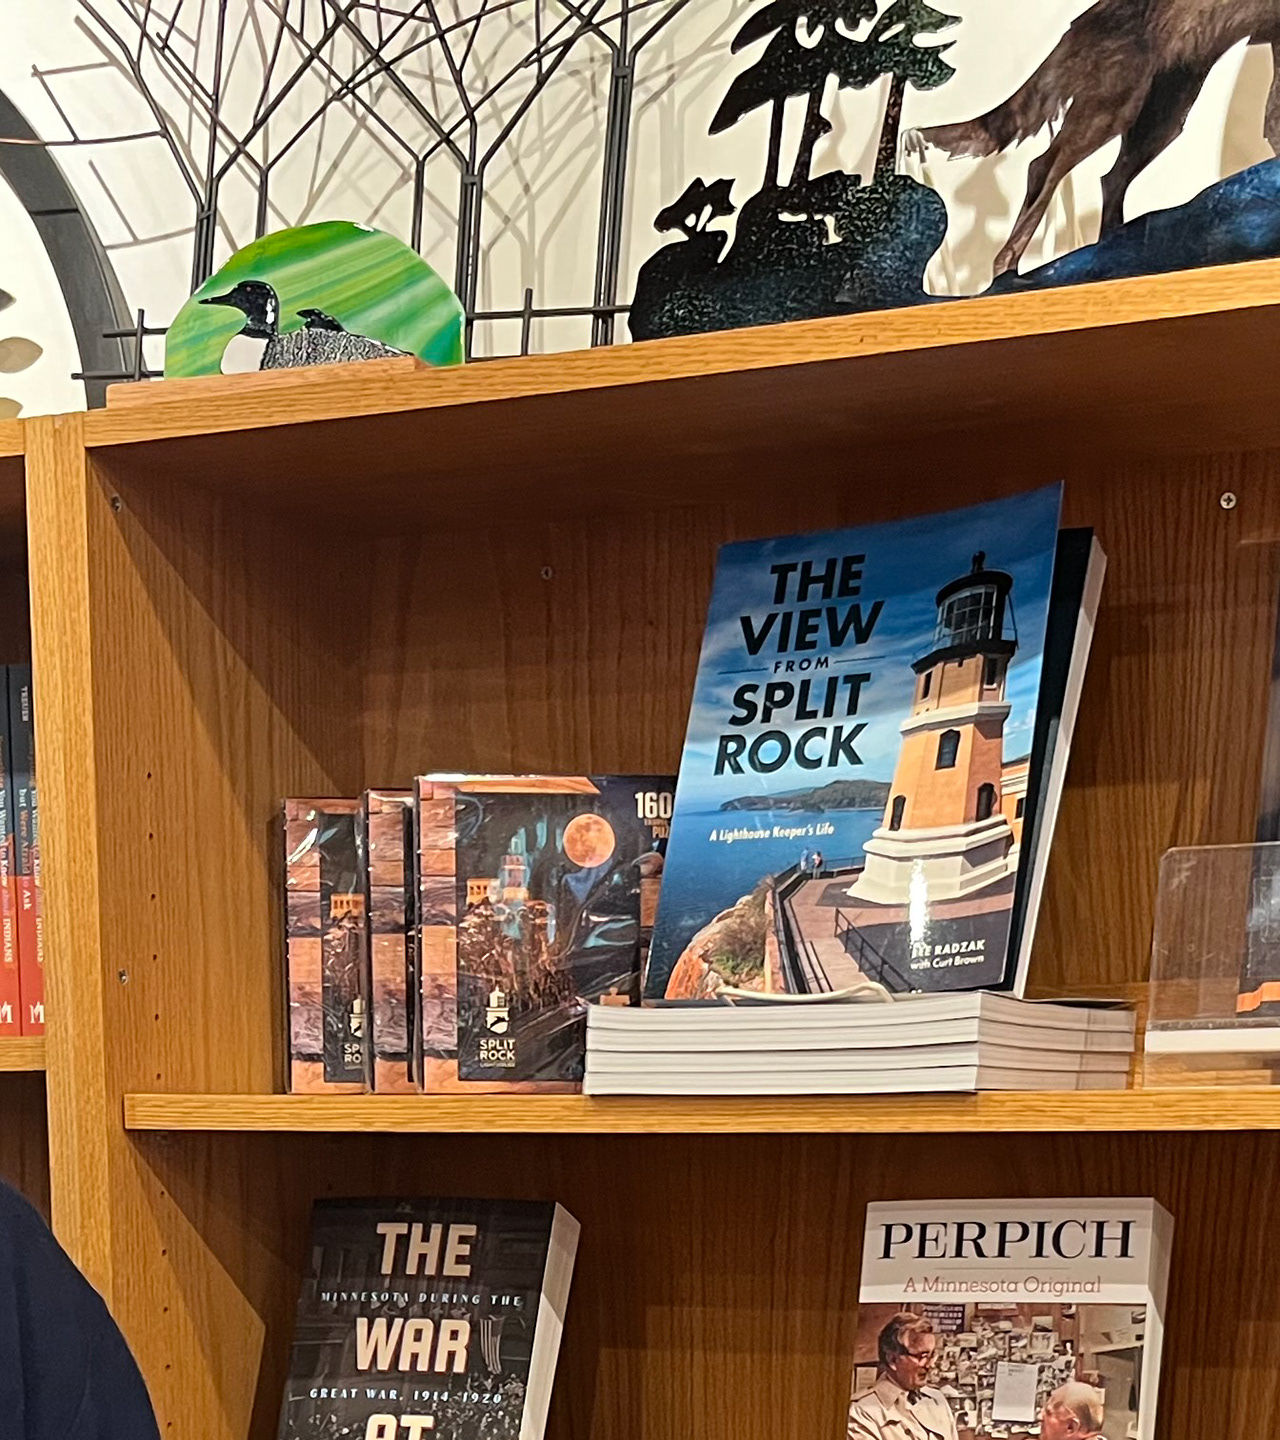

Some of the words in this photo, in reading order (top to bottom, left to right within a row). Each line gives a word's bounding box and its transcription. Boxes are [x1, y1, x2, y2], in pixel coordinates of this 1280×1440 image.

[770, 554, 865, 604] THE
[740, 601, 885, 656] VIEW
[774, 657, 829, 673] FROM
[729, 673, 871, 725] SPLIT
[714, 723, 868, 776] ROCK
[710, 830, 718, 841] A
[719, 827, 770, 843] Lighthouse
[773, 825, 814, 840] Keeper's
[816, 823, 834, 835] Life
[935, 940, 985, 955] RADZAK
[480, 1039, 515, 1050] SPLIT
[480, 1051, 515, 1061] ROCK
[376, 1222, 477, 1276] THE
[877, 1219, 1136, 1260] PERPICH
[903, 1278, 917, 1293] A
[922, 1276, 1019, 1294] Minnesota
[1023, 1276, 1101, 1297] Original
[321, 1292, 408, 1304] MINNESOTA
[419, 1292, 480, 1305] DURING
[491, 1295, 521, 1307] THE
[356, 1317, 471, 1373] WAR
[309, 1388, 358, 1399] GREAT
[366, 1388, 404, 1400] WAR,
